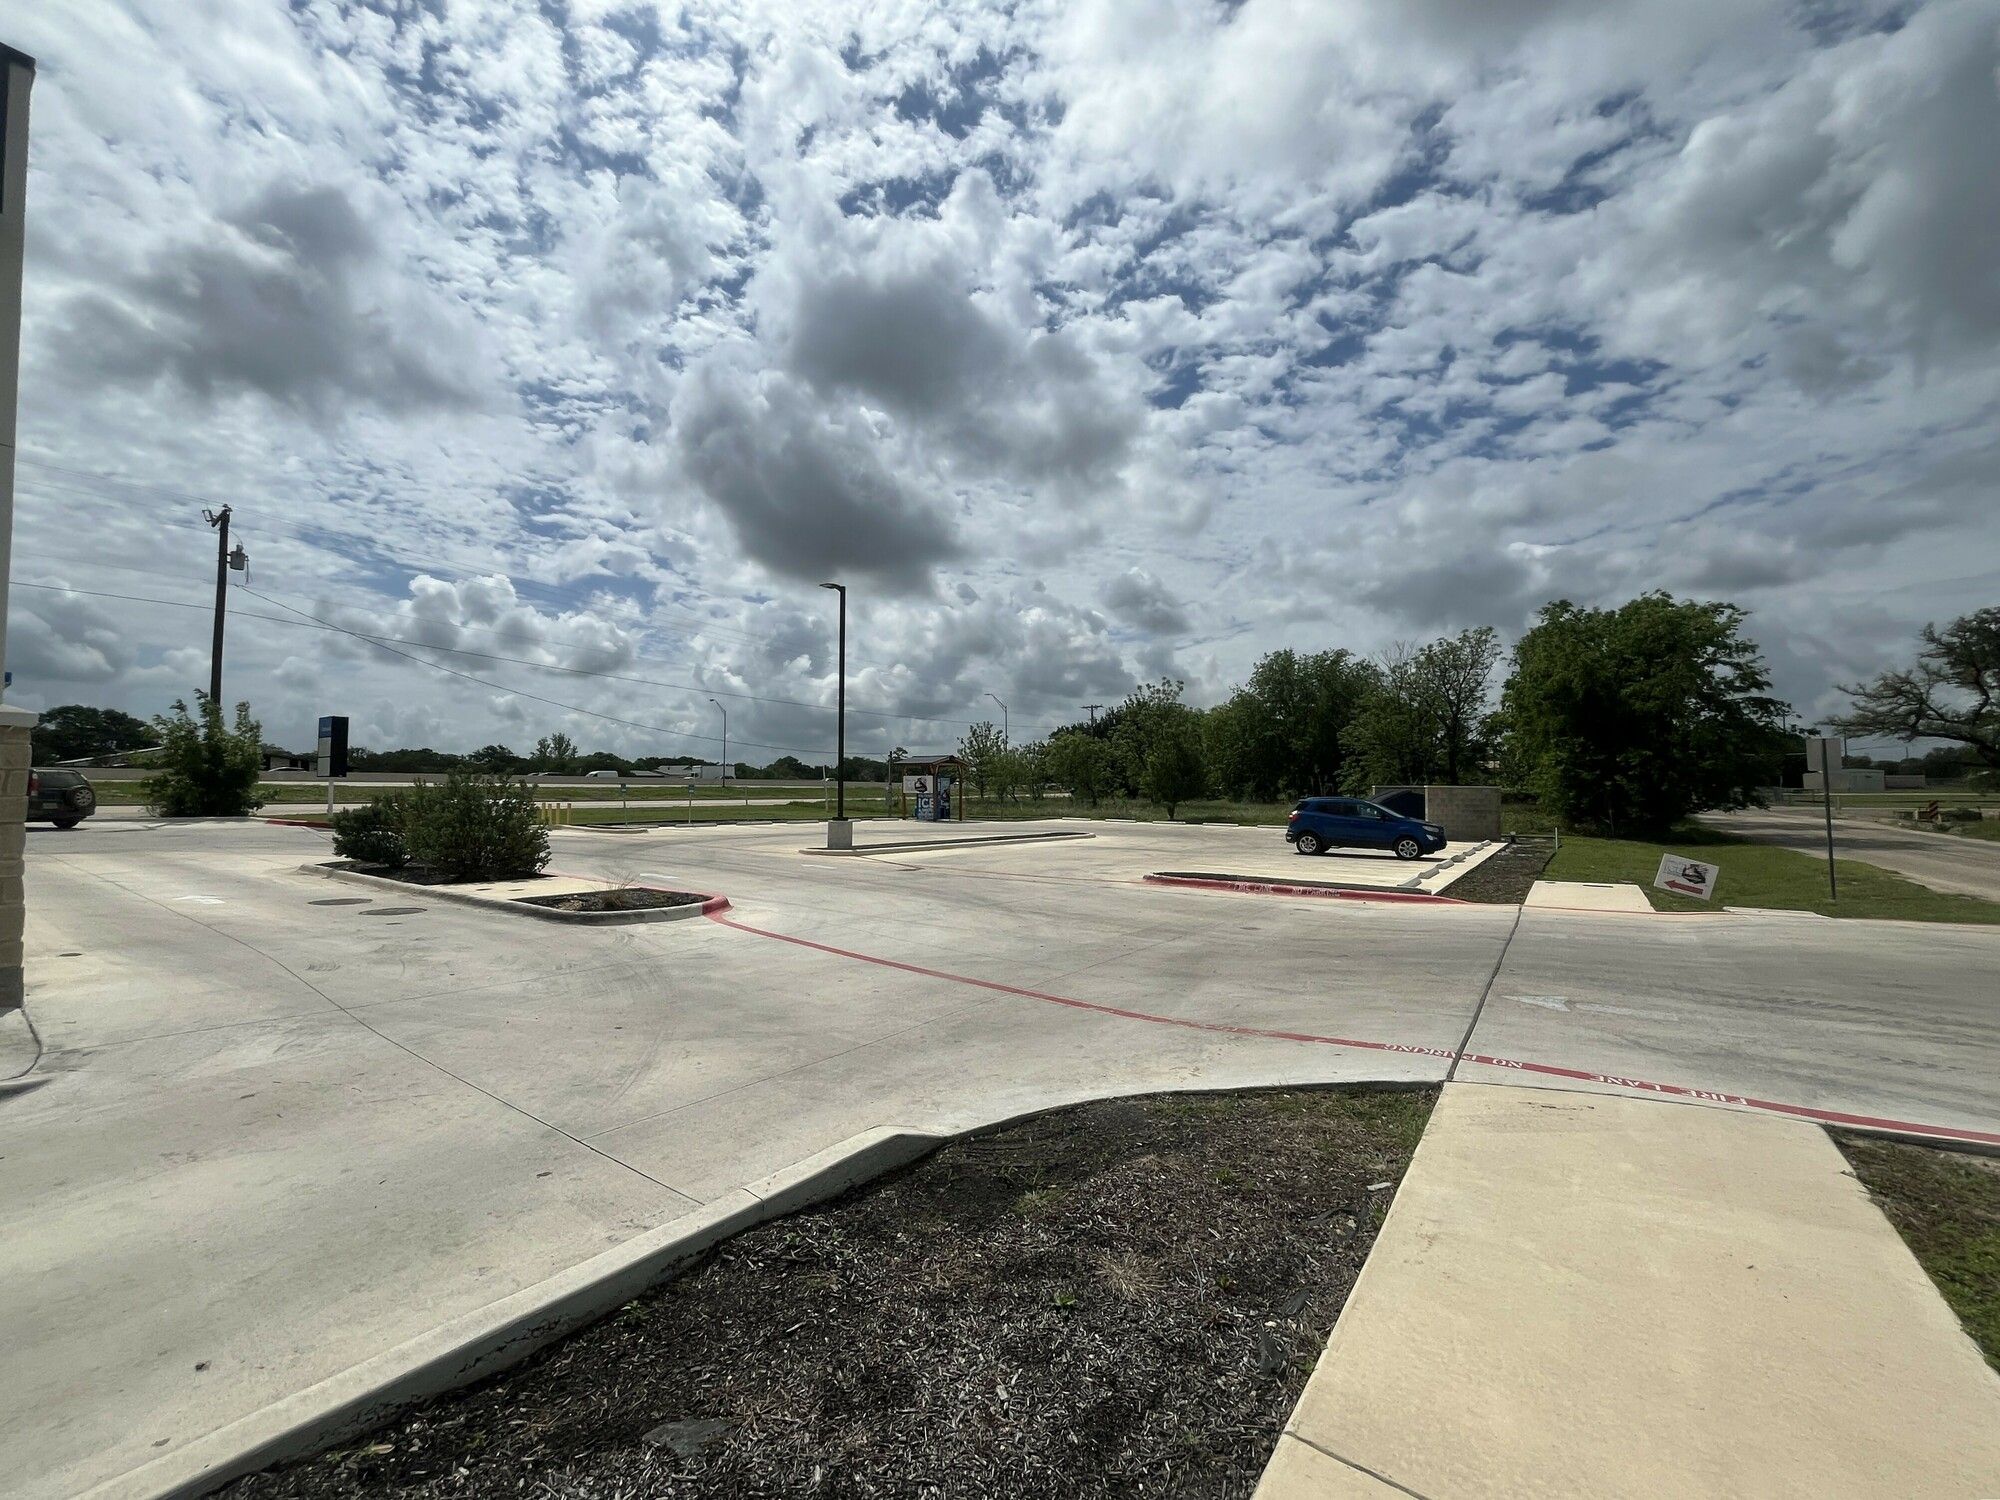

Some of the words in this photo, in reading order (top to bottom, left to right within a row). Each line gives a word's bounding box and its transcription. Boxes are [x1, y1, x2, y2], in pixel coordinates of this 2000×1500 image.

[1383, 1043, 1478, 1061] PARKING
[1492, 1058, 1523, 1069] NO
[1590, 1074, 1662, 1092] LANE
[1681, 1089, 1748, 1105] FIRE
